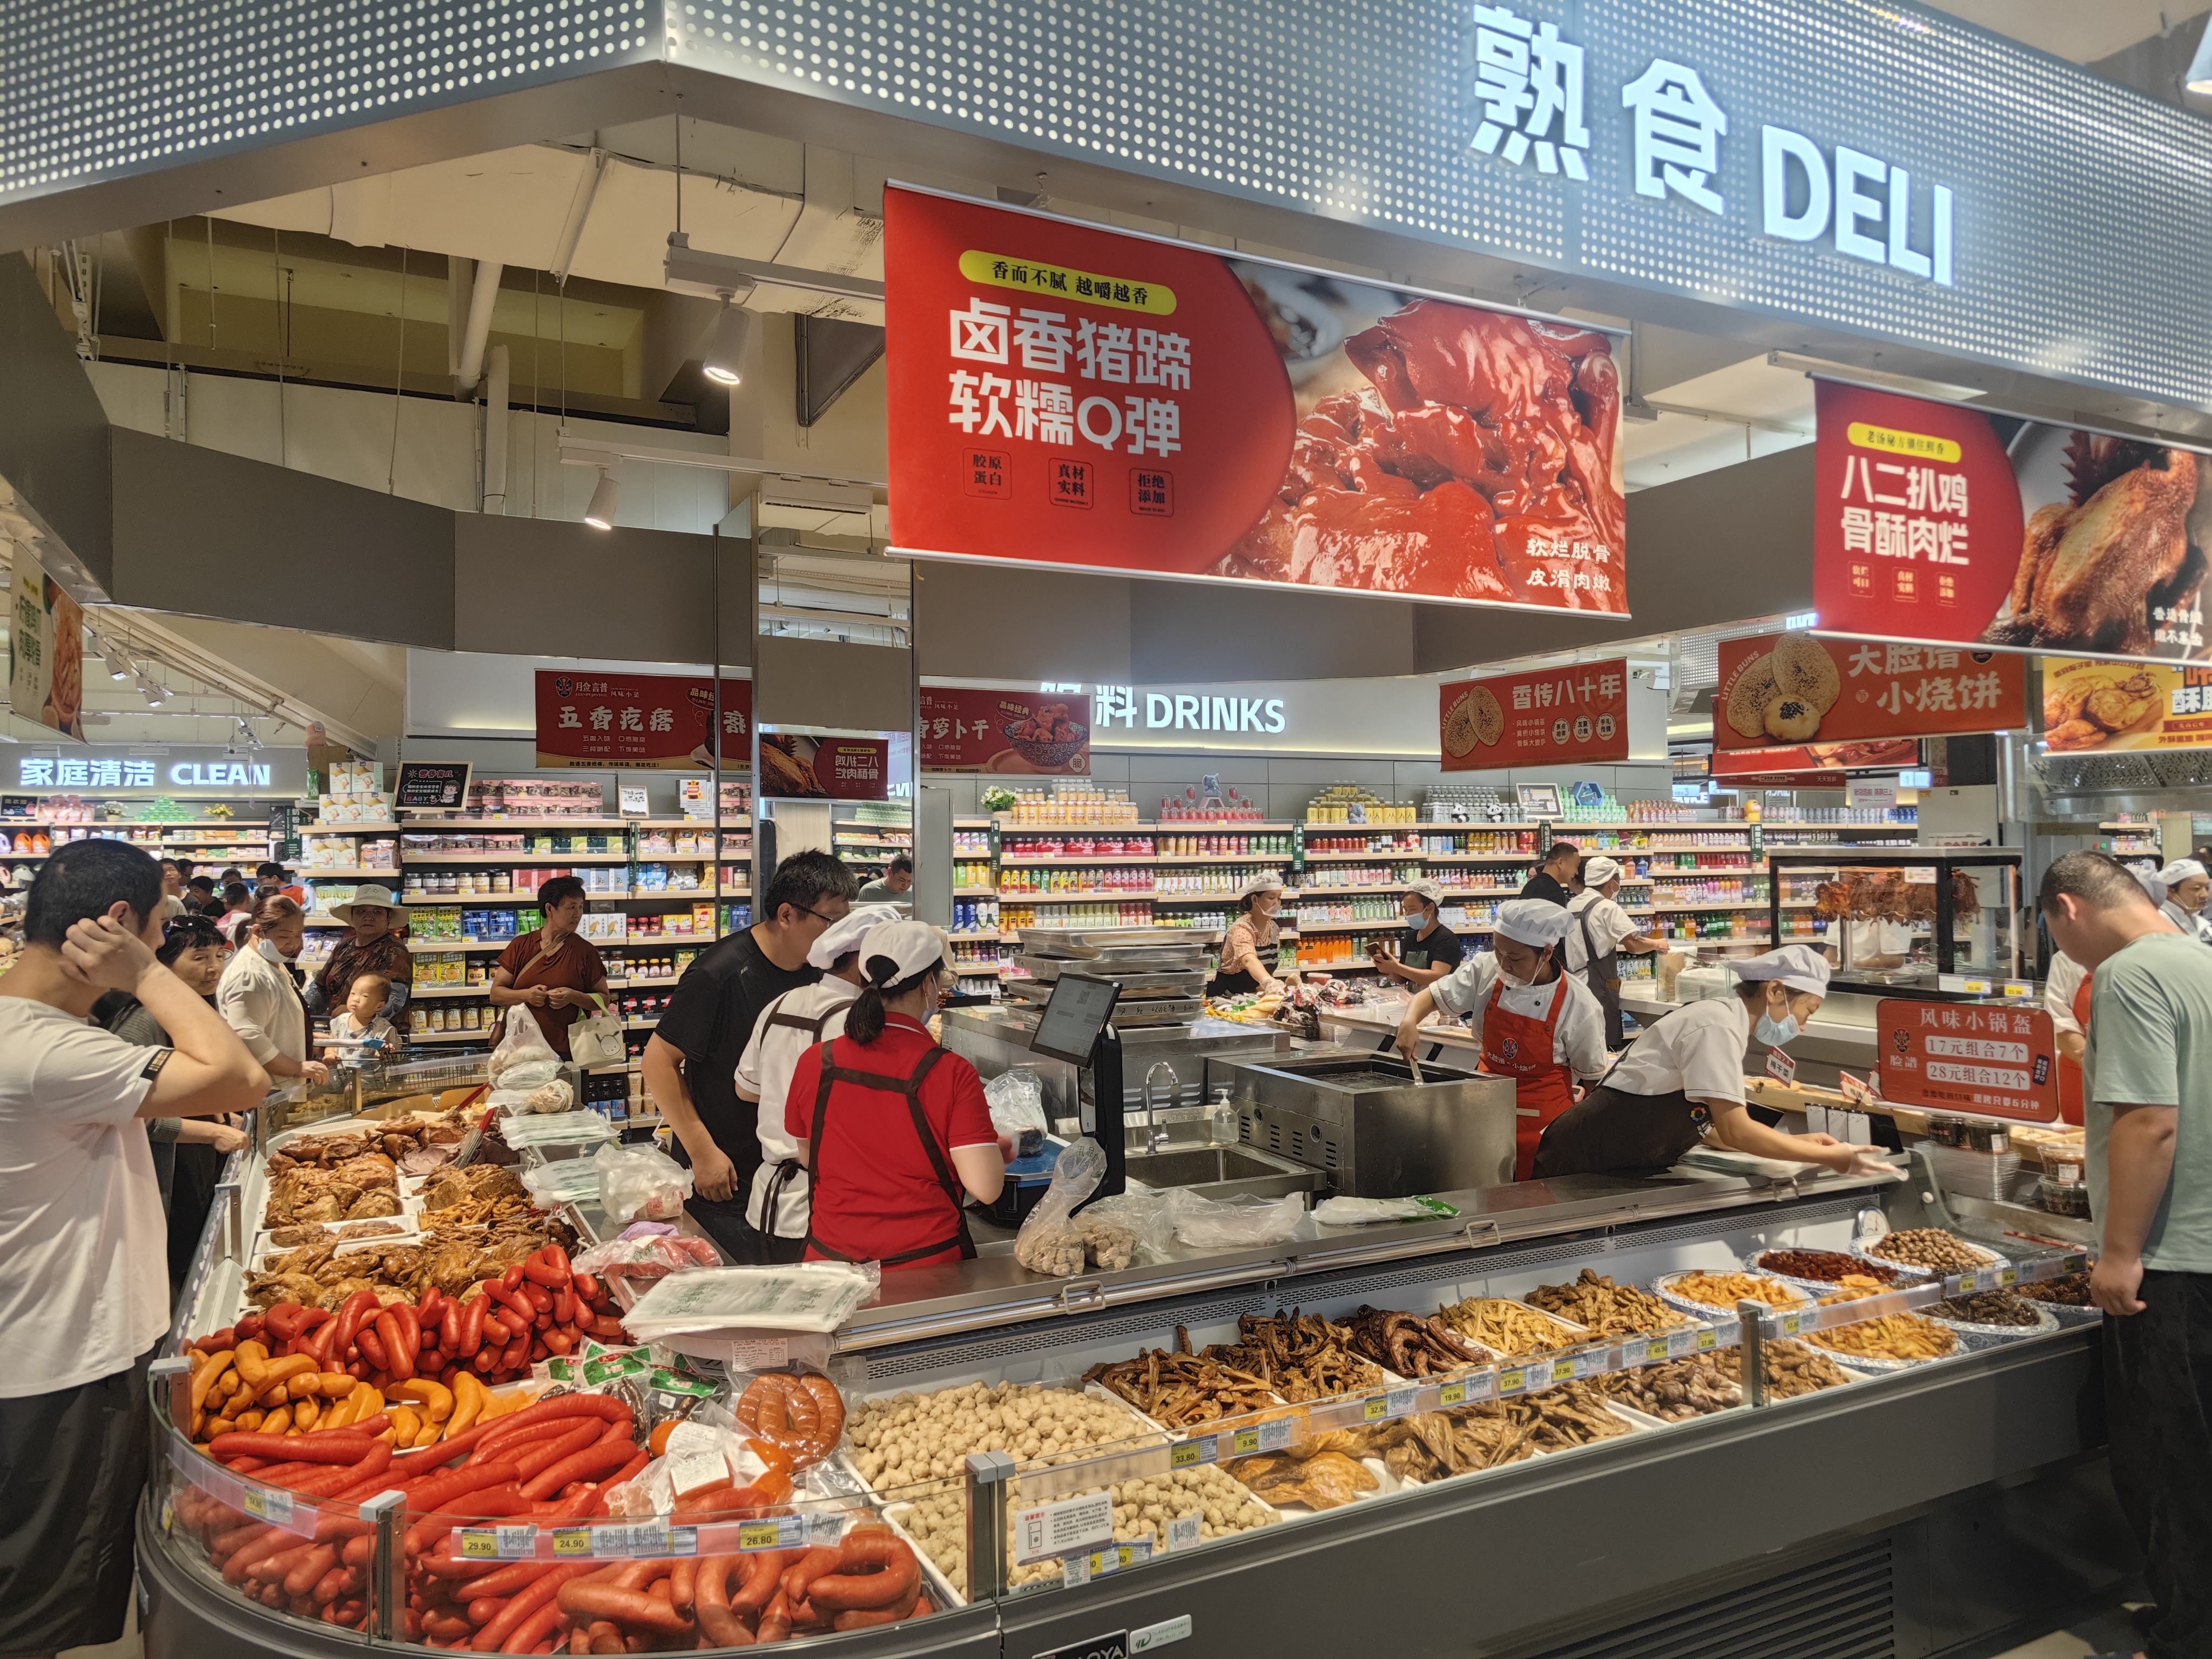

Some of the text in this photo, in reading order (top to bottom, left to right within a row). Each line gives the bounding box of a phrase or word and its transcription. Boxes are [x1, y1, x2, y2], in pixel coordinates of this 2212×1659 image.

[1470, 4, 1953, 286] 熟食 DELI
[992, 261, 1148, 306] 香而不腻 越嚼越香
[949, 296, 1191, 390] 卤香猪蹄
[949, 369, 1182, 458] 软糯Q弹
[973, 455, 1002, 469] 胶原
[1058, 464, 1085, 481] 真材
[974, 471, 1002, 486] 蛋白
[1057, 480, 1085, 496] 实料
[1138, 473, 1165, 488] 拒绝
[1840, 455, 1968, 517] 八二扒鸡
[1138, 489, 1165, 504] 添加
[1840, 506, 1970, 565] 骨酥肉烂
[1526, 538, 1610, 563] 软烂脱骨
[1526, 568, 1611, 592] 皮滑肉嫩
[1721, 651, 1759, 701] LITTLE BUNS
[1512, 674, 1622, 710] 香传八十年
[1876, 671, 2002, 715] 小烧饼
[558, 705, 674, 732] 五香疙瘩
[1000, 701, 1029, 716] 品味经典
[1147, 693, 1285, 733] DRINKS
[1441, 691, 1469, 730] LITTLE BUNS
[21, 759, 269, 786] 家庭清洁 CLEAN
[1920, 1008, 2032, 1035] 风味小锅盔
[1929, 1038, 2024, 1061] 17元组合7个
[1930, 1064, 2027, 1088] 28元组合12个
[1503, 1378, 1519, 1387] 37.90
[1555, 1367, 1570, 1375] 37.90
[1445, 1393, 1460, 1401] 19.90
[1370, 1405, 1387, 1414] 32.90
[1243, 1438, 1257, 1447] 9.90
[1175, 1453, 1195, 1463] 33.80
[468, 1542, 491, 1551] 29.90
[746, 1536, 772, 1546] 26.80
